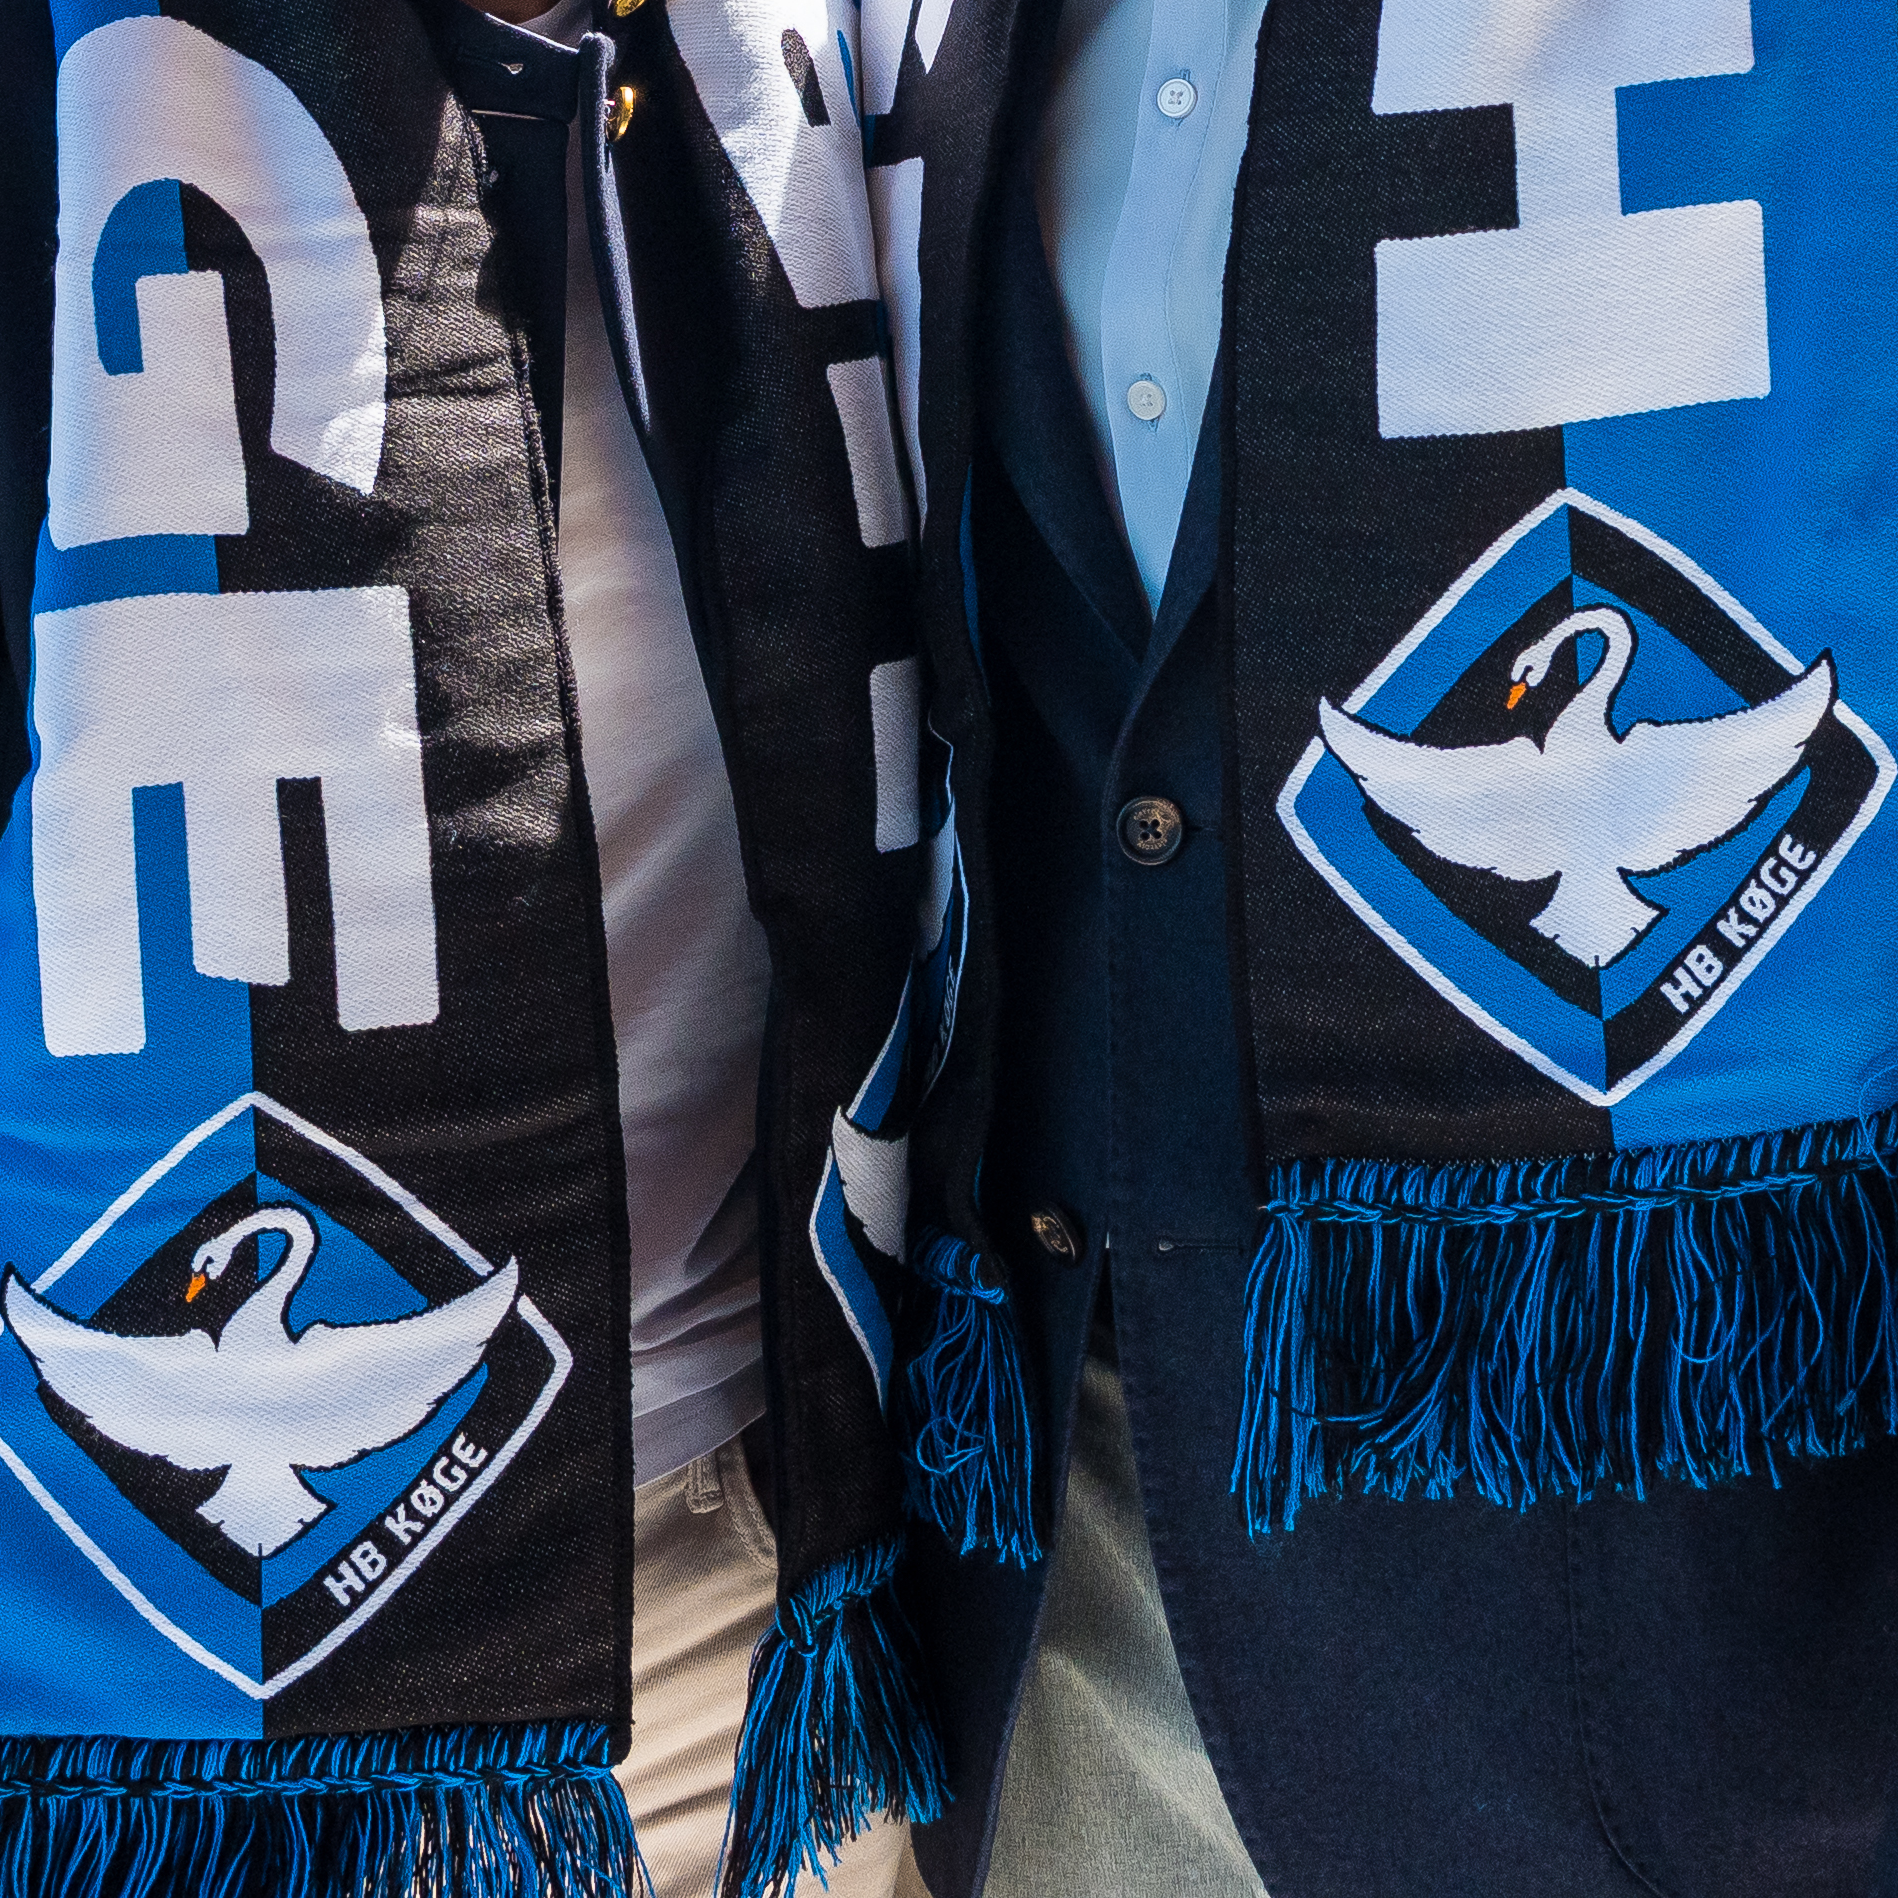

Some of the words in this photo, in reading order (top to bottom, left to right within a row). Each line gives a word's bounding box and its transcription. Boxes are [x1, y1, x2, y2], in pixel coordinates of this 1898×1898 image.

[1659, 944, 1724, 1014] HB
[1716, 833, 1817, 948] KØGE
[323, 1540, 388, 1607] HB
[384, 1431, 489, 1546] KØGE
